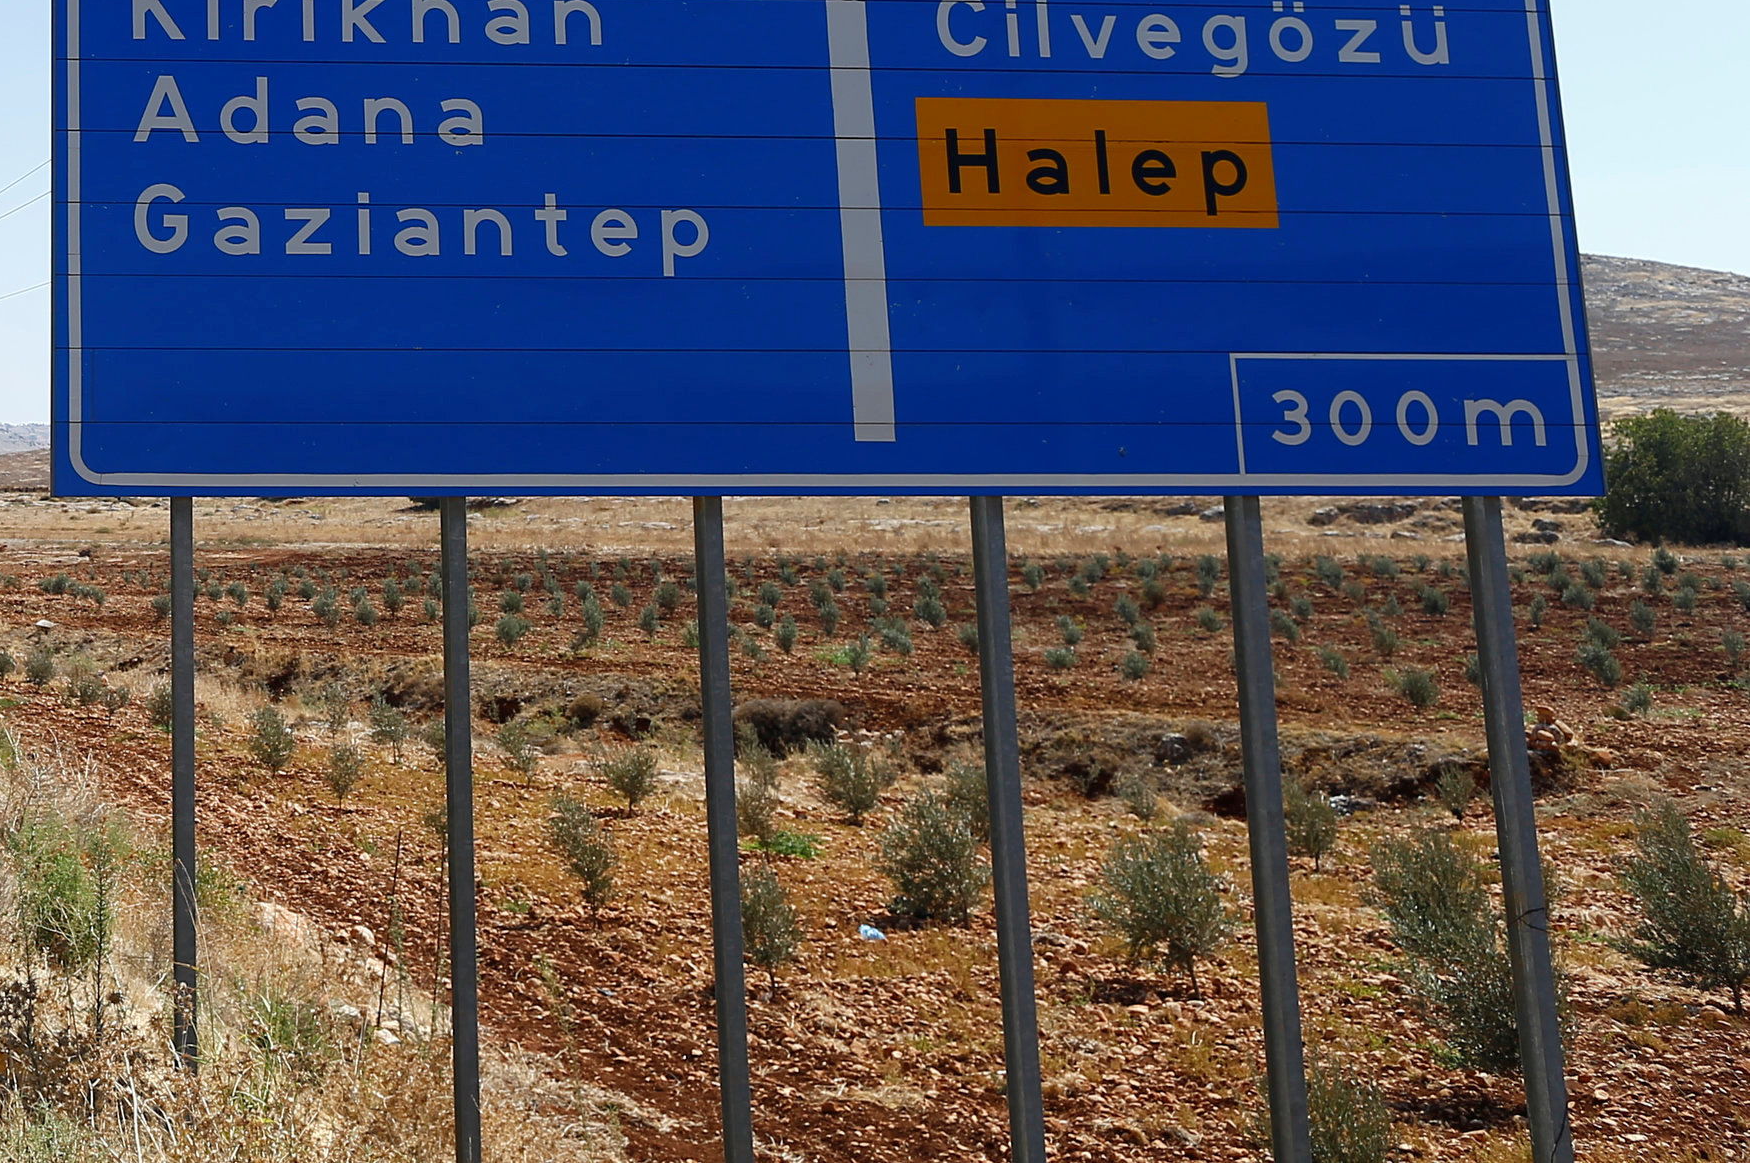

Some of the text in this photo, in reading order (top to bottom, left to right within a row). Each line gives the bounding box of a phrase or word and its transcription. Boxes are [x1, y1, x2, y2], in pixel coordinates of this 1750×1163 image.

[134, 74, 485, 147] Adana
[945, 127, 1248, 216] Halep
[134, 183, 710, 277] Gaziantep
